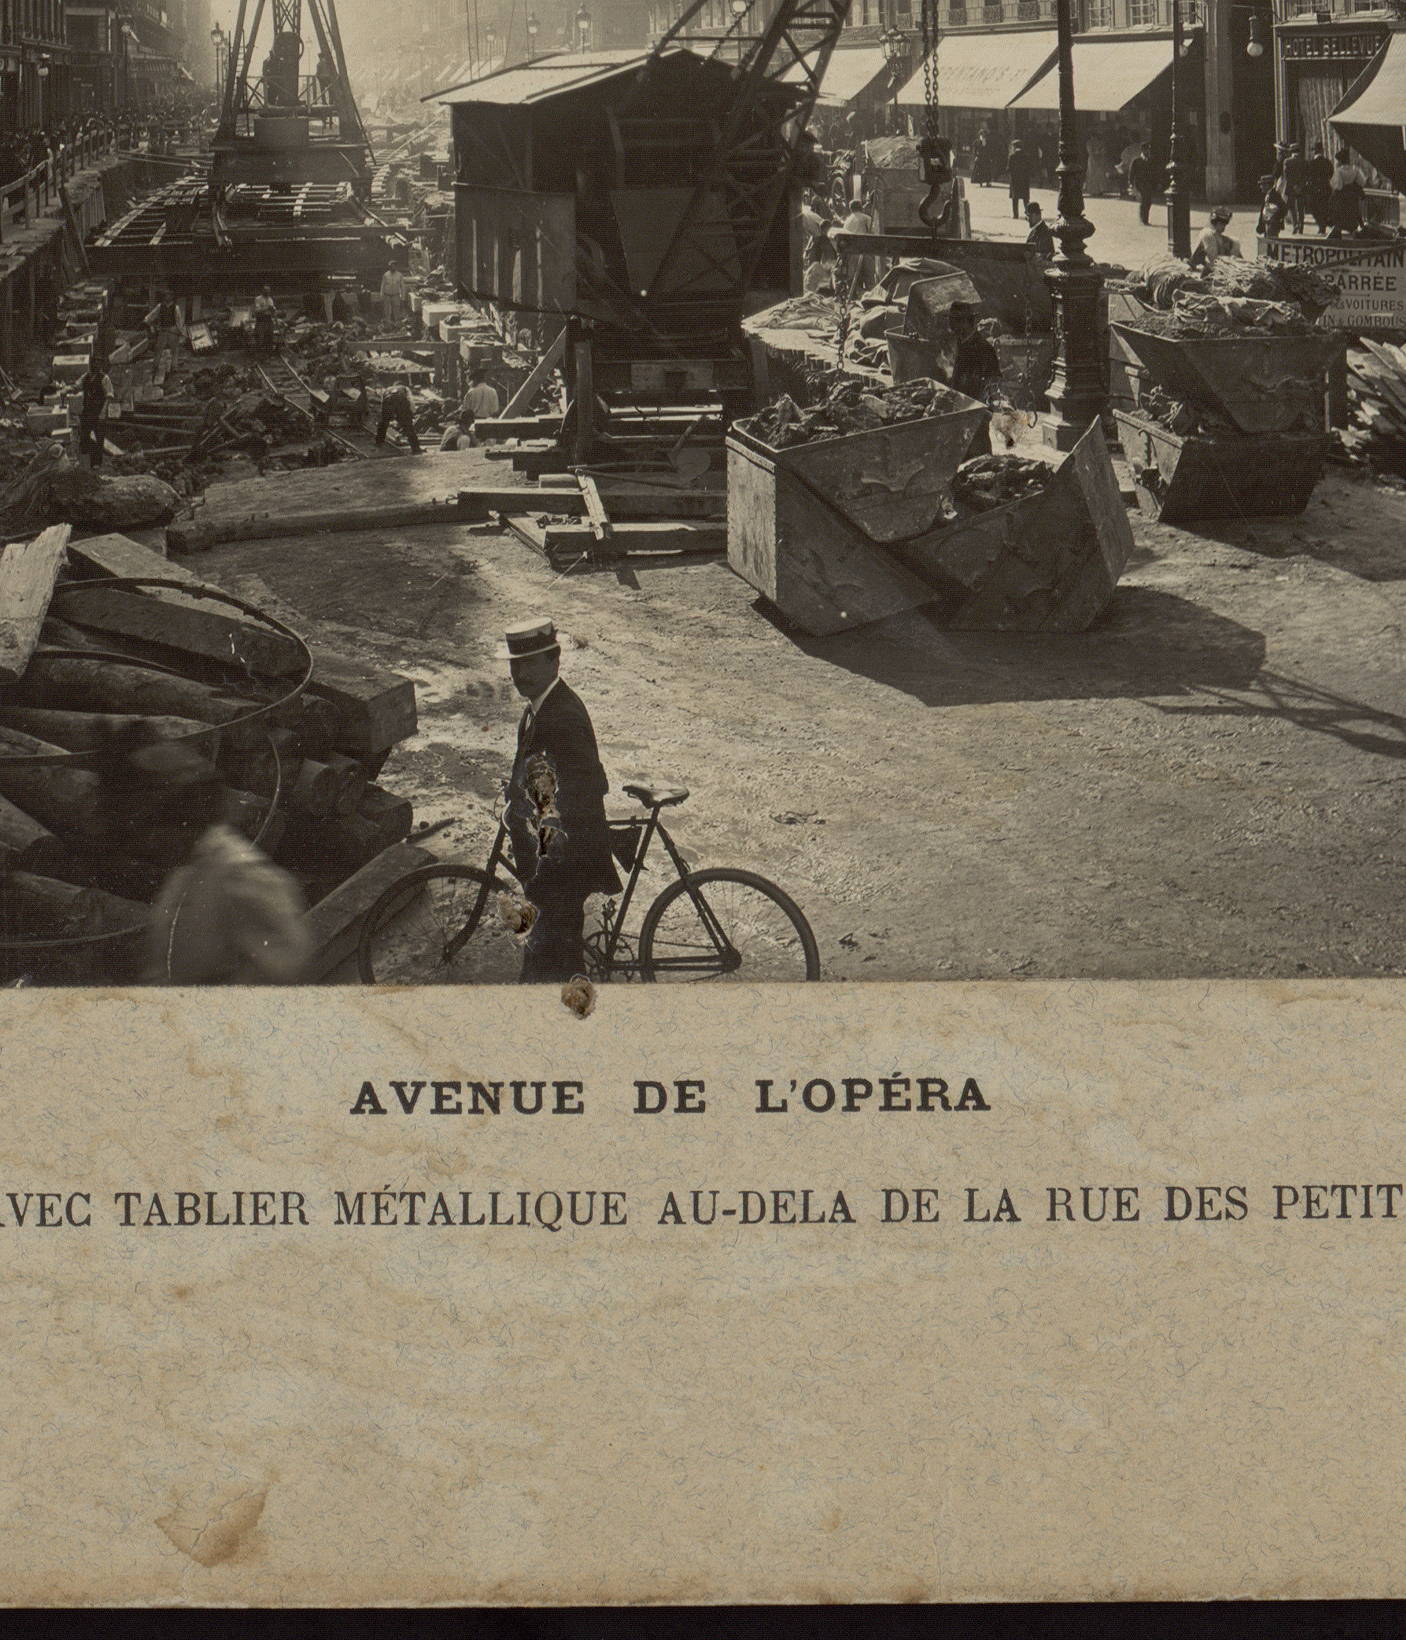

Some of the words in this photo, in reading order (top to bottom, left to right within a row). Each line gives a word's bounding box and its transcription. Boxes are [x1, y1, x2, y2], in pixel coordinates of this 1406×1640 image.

[1285, 38, 1319, 56] HOTEL
[1323, 36, 1382, 56] BELLEVUE
[1346, 299, 1404, 310] VOITURES
[349, 1079, 585, 1116] AVENUE
[632, 1078, 707, 1115] DE
[754, 1070, 992, 1114] L'OPÉRA
[113, 1190, 310, 1227] TABLIER
[333, 1183, 628, 1233] MÉTALLIQUE
[657, 1189, 857, 1227] AU-DELA
[879, 1187, 940, 1224] DE
[962, 1187, 1022, 1225] LA
[1045, 1186, 1140, 1223] RUE
[1163, 1185, 1249, 1223] DES
